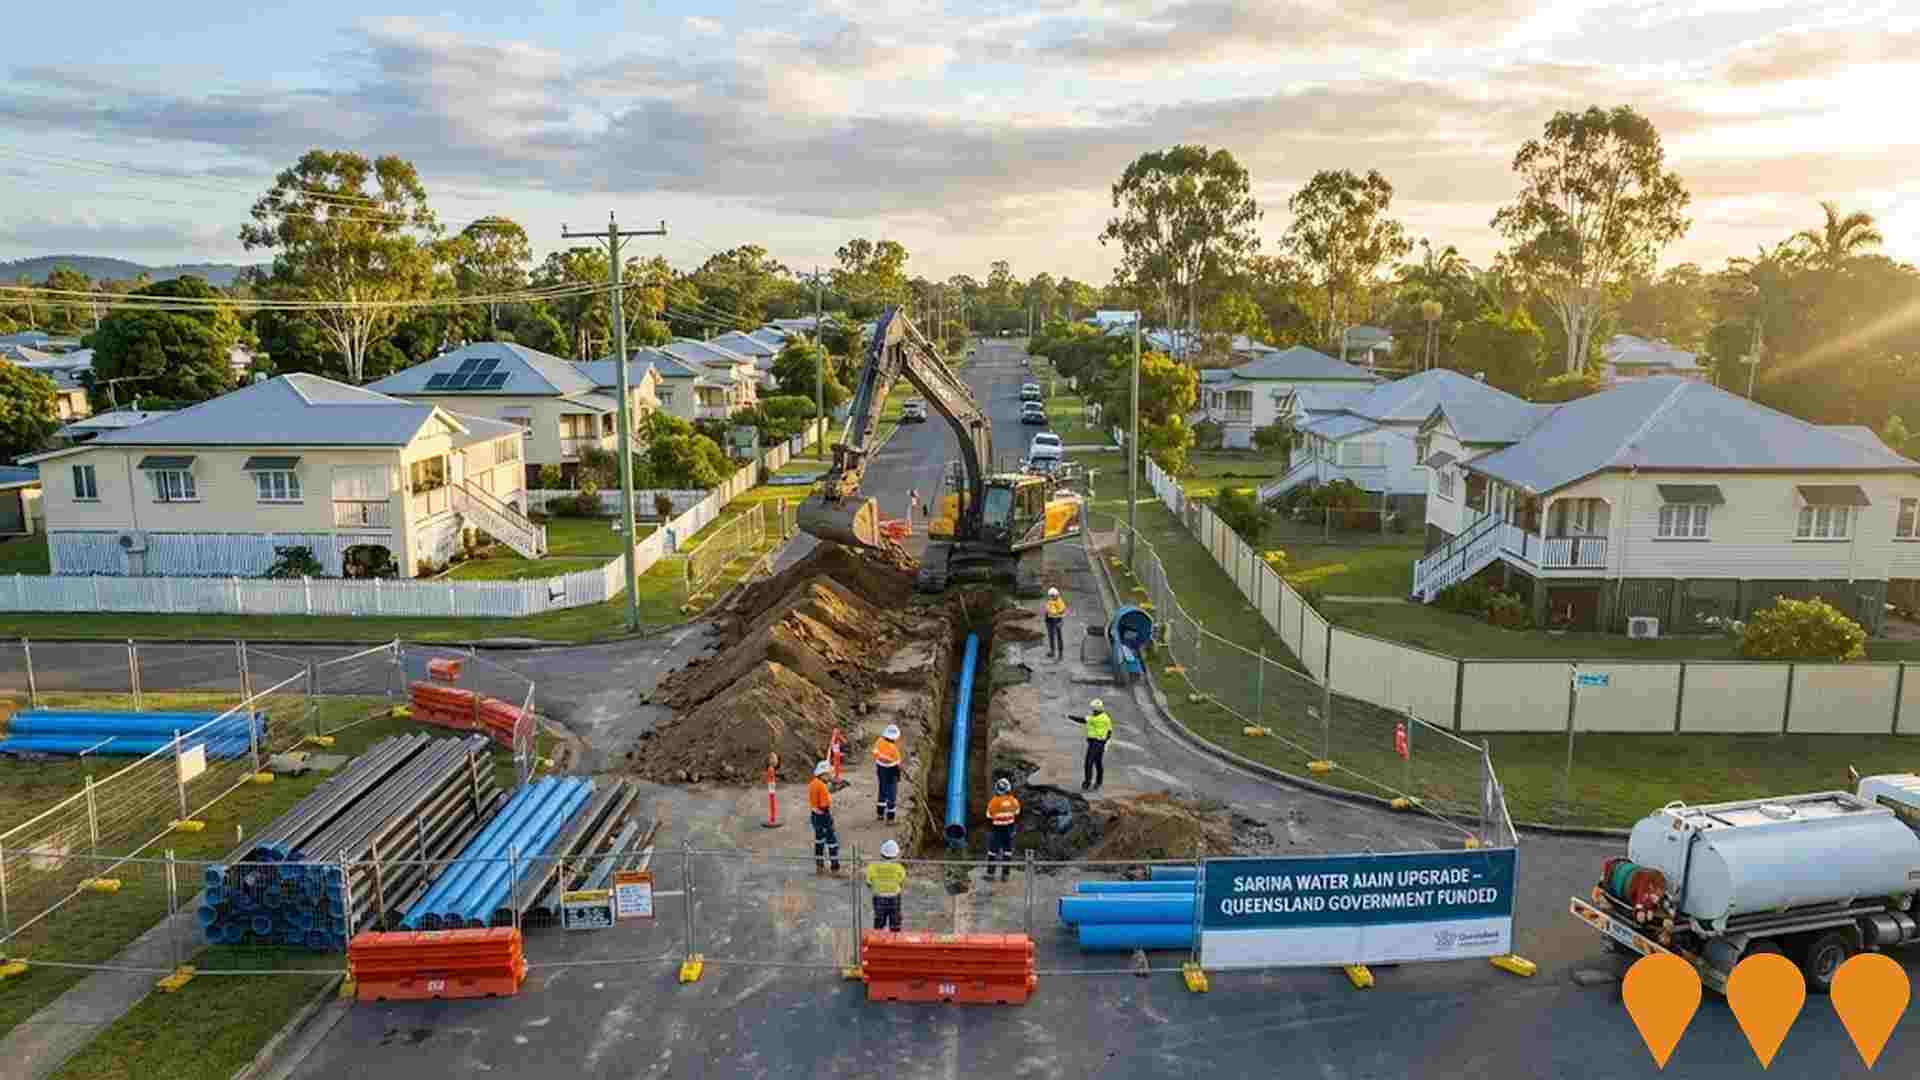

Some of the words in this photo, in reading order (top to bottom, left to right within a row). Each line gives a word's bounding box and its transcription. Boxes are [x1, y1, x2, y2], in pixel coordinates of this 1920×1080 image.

[1233, 875, 1293, 892] SARINA
[1295, 873, 1349, 890] WATER
[1398, 869, 1470, 887] UPGRADE
[1220, 896, 1325, 916] QUEENSLAND
[1328, 890, 1435, 911] GOVERNMENT
[1437, 887, 1497, 905] FUNDED
